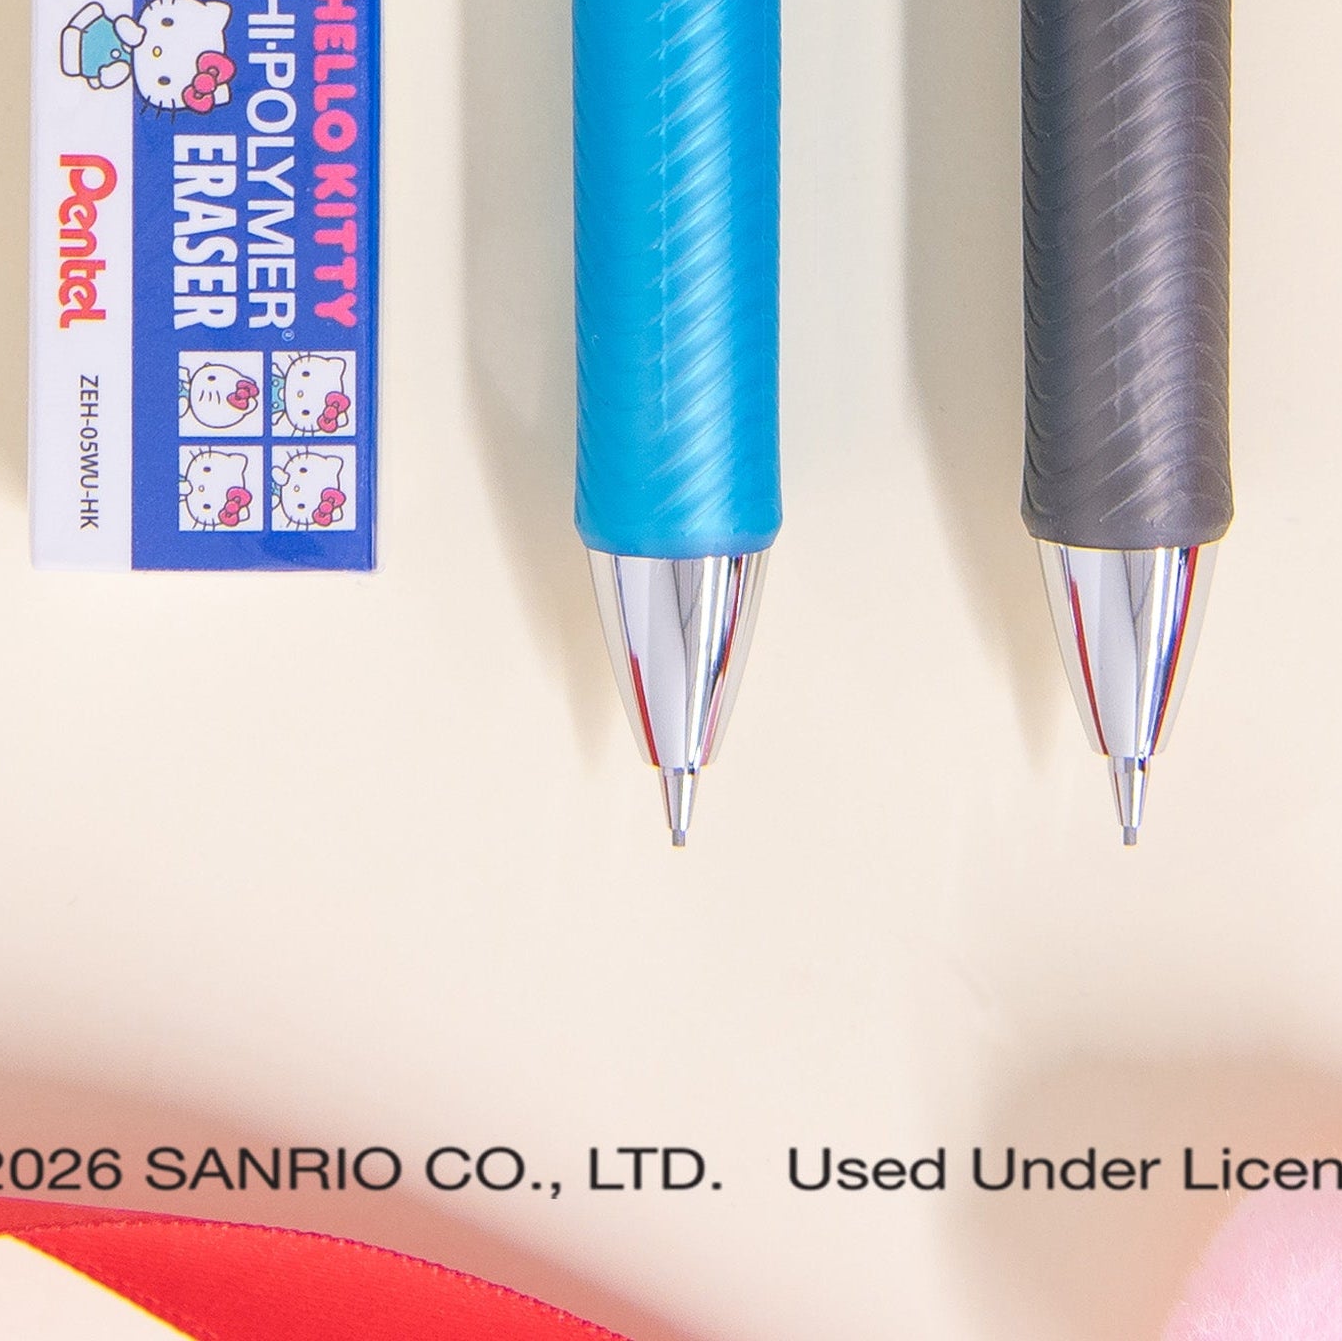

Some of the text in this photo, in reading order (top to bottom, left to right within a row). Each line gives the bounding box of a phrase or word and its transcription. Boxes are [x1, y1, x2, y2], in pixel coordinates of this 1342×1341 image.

[58, 153, 118, 330] Pentel
[173, 133, 238, 330] ERASER
[312, 163, 358, 329] KITTY
[78, 374, 100, 530] ZEH-05WU-HK
